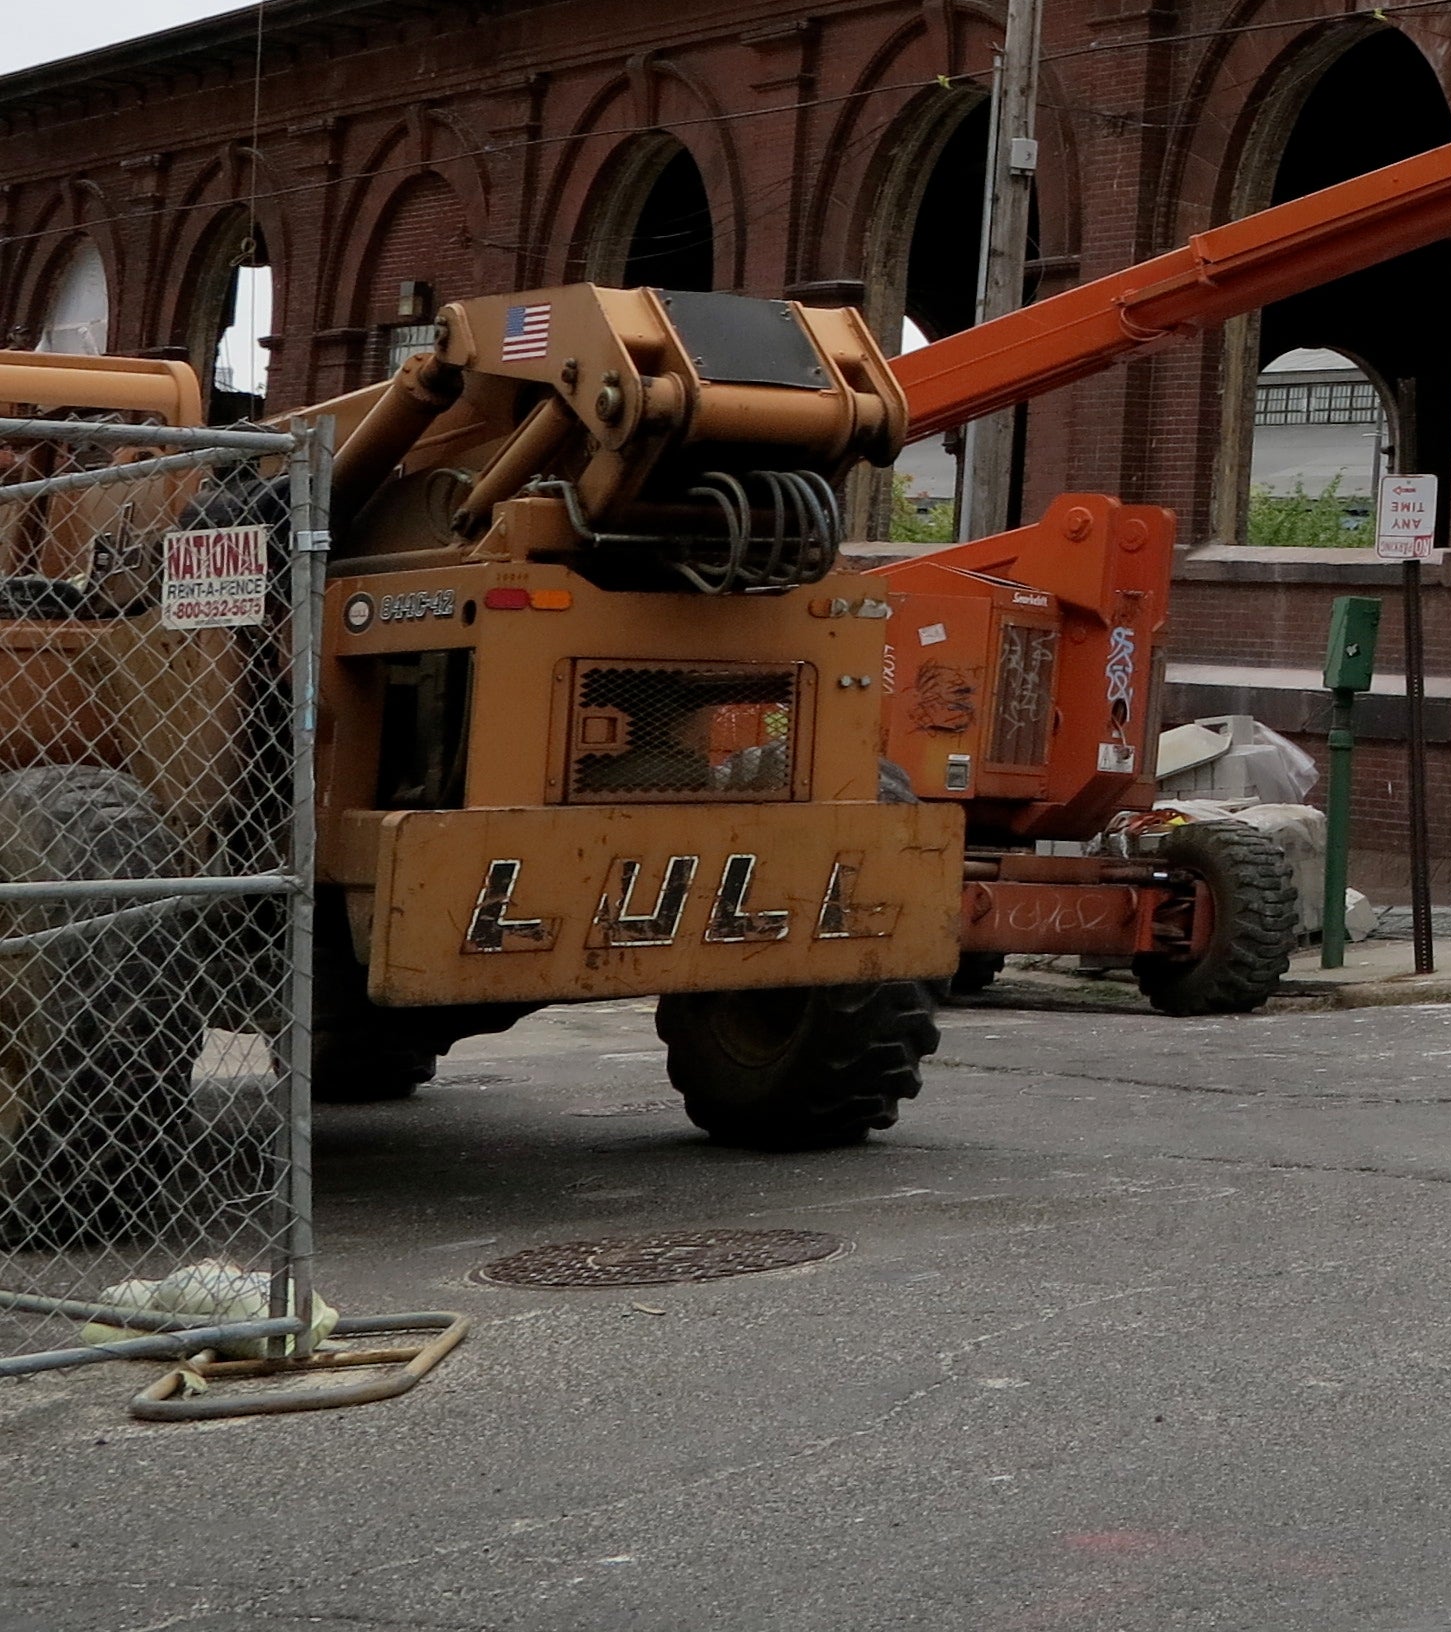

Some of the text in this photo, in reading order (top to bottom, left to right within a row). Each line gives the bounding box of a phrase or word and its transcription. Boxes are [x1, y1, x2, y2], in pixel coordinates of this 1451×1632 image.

[1391, 501, 1425, 513] TIME
[1391, 518, 1422, 529] ANY
[167, 531, 264, 581] NATIONAL
[167, 578, 263, 599] RENT-A-FENCE
[460, 848, 903, 955] LULL
